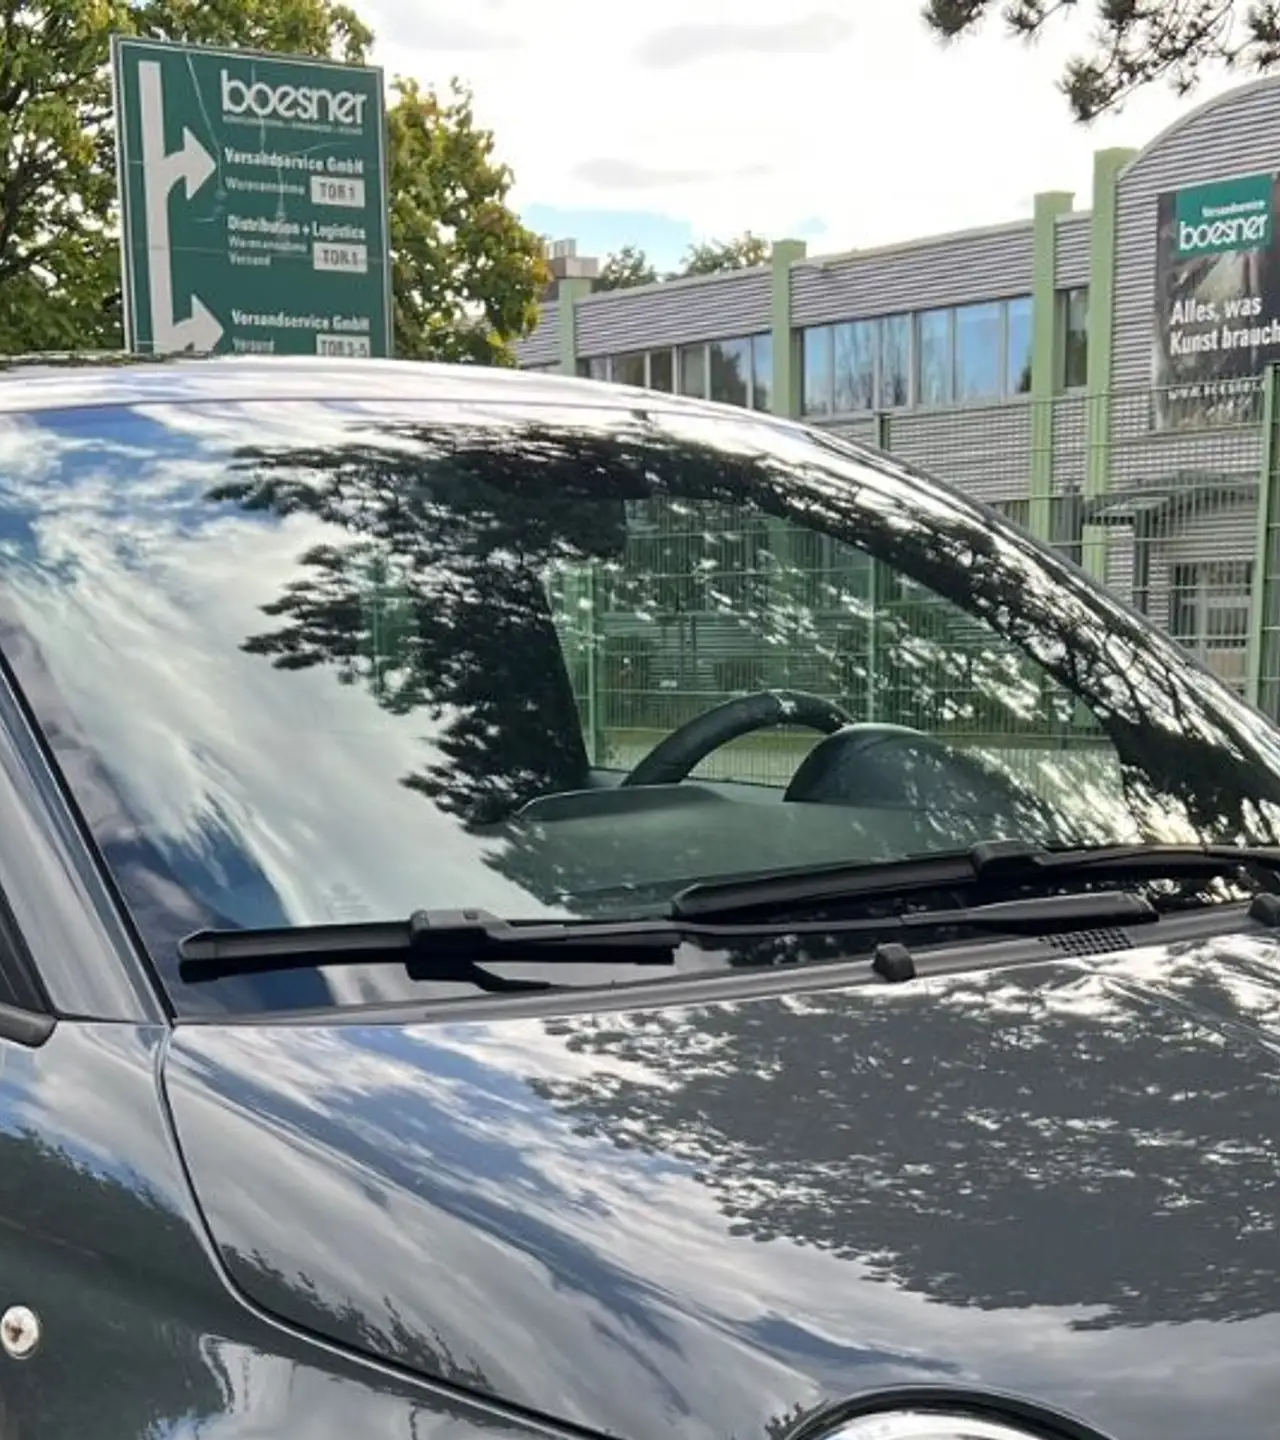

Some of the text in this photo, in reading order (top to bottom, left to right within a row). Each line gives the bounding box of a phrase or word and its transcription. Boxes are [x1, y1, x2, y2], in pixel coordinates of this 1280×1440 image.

[220, 68, 368, 124] boesner
[224, 147, 364, 174] Versandservice GmbH
[312, 220, 366, 241] Logistics
[1179, 214, 1268, 252] boesner
[231, 308, 370, 331] Versandservice GmbH
[1169, 297, 1263, 325] Alles, was
[1170, 328, 1218, 356] Kunst
